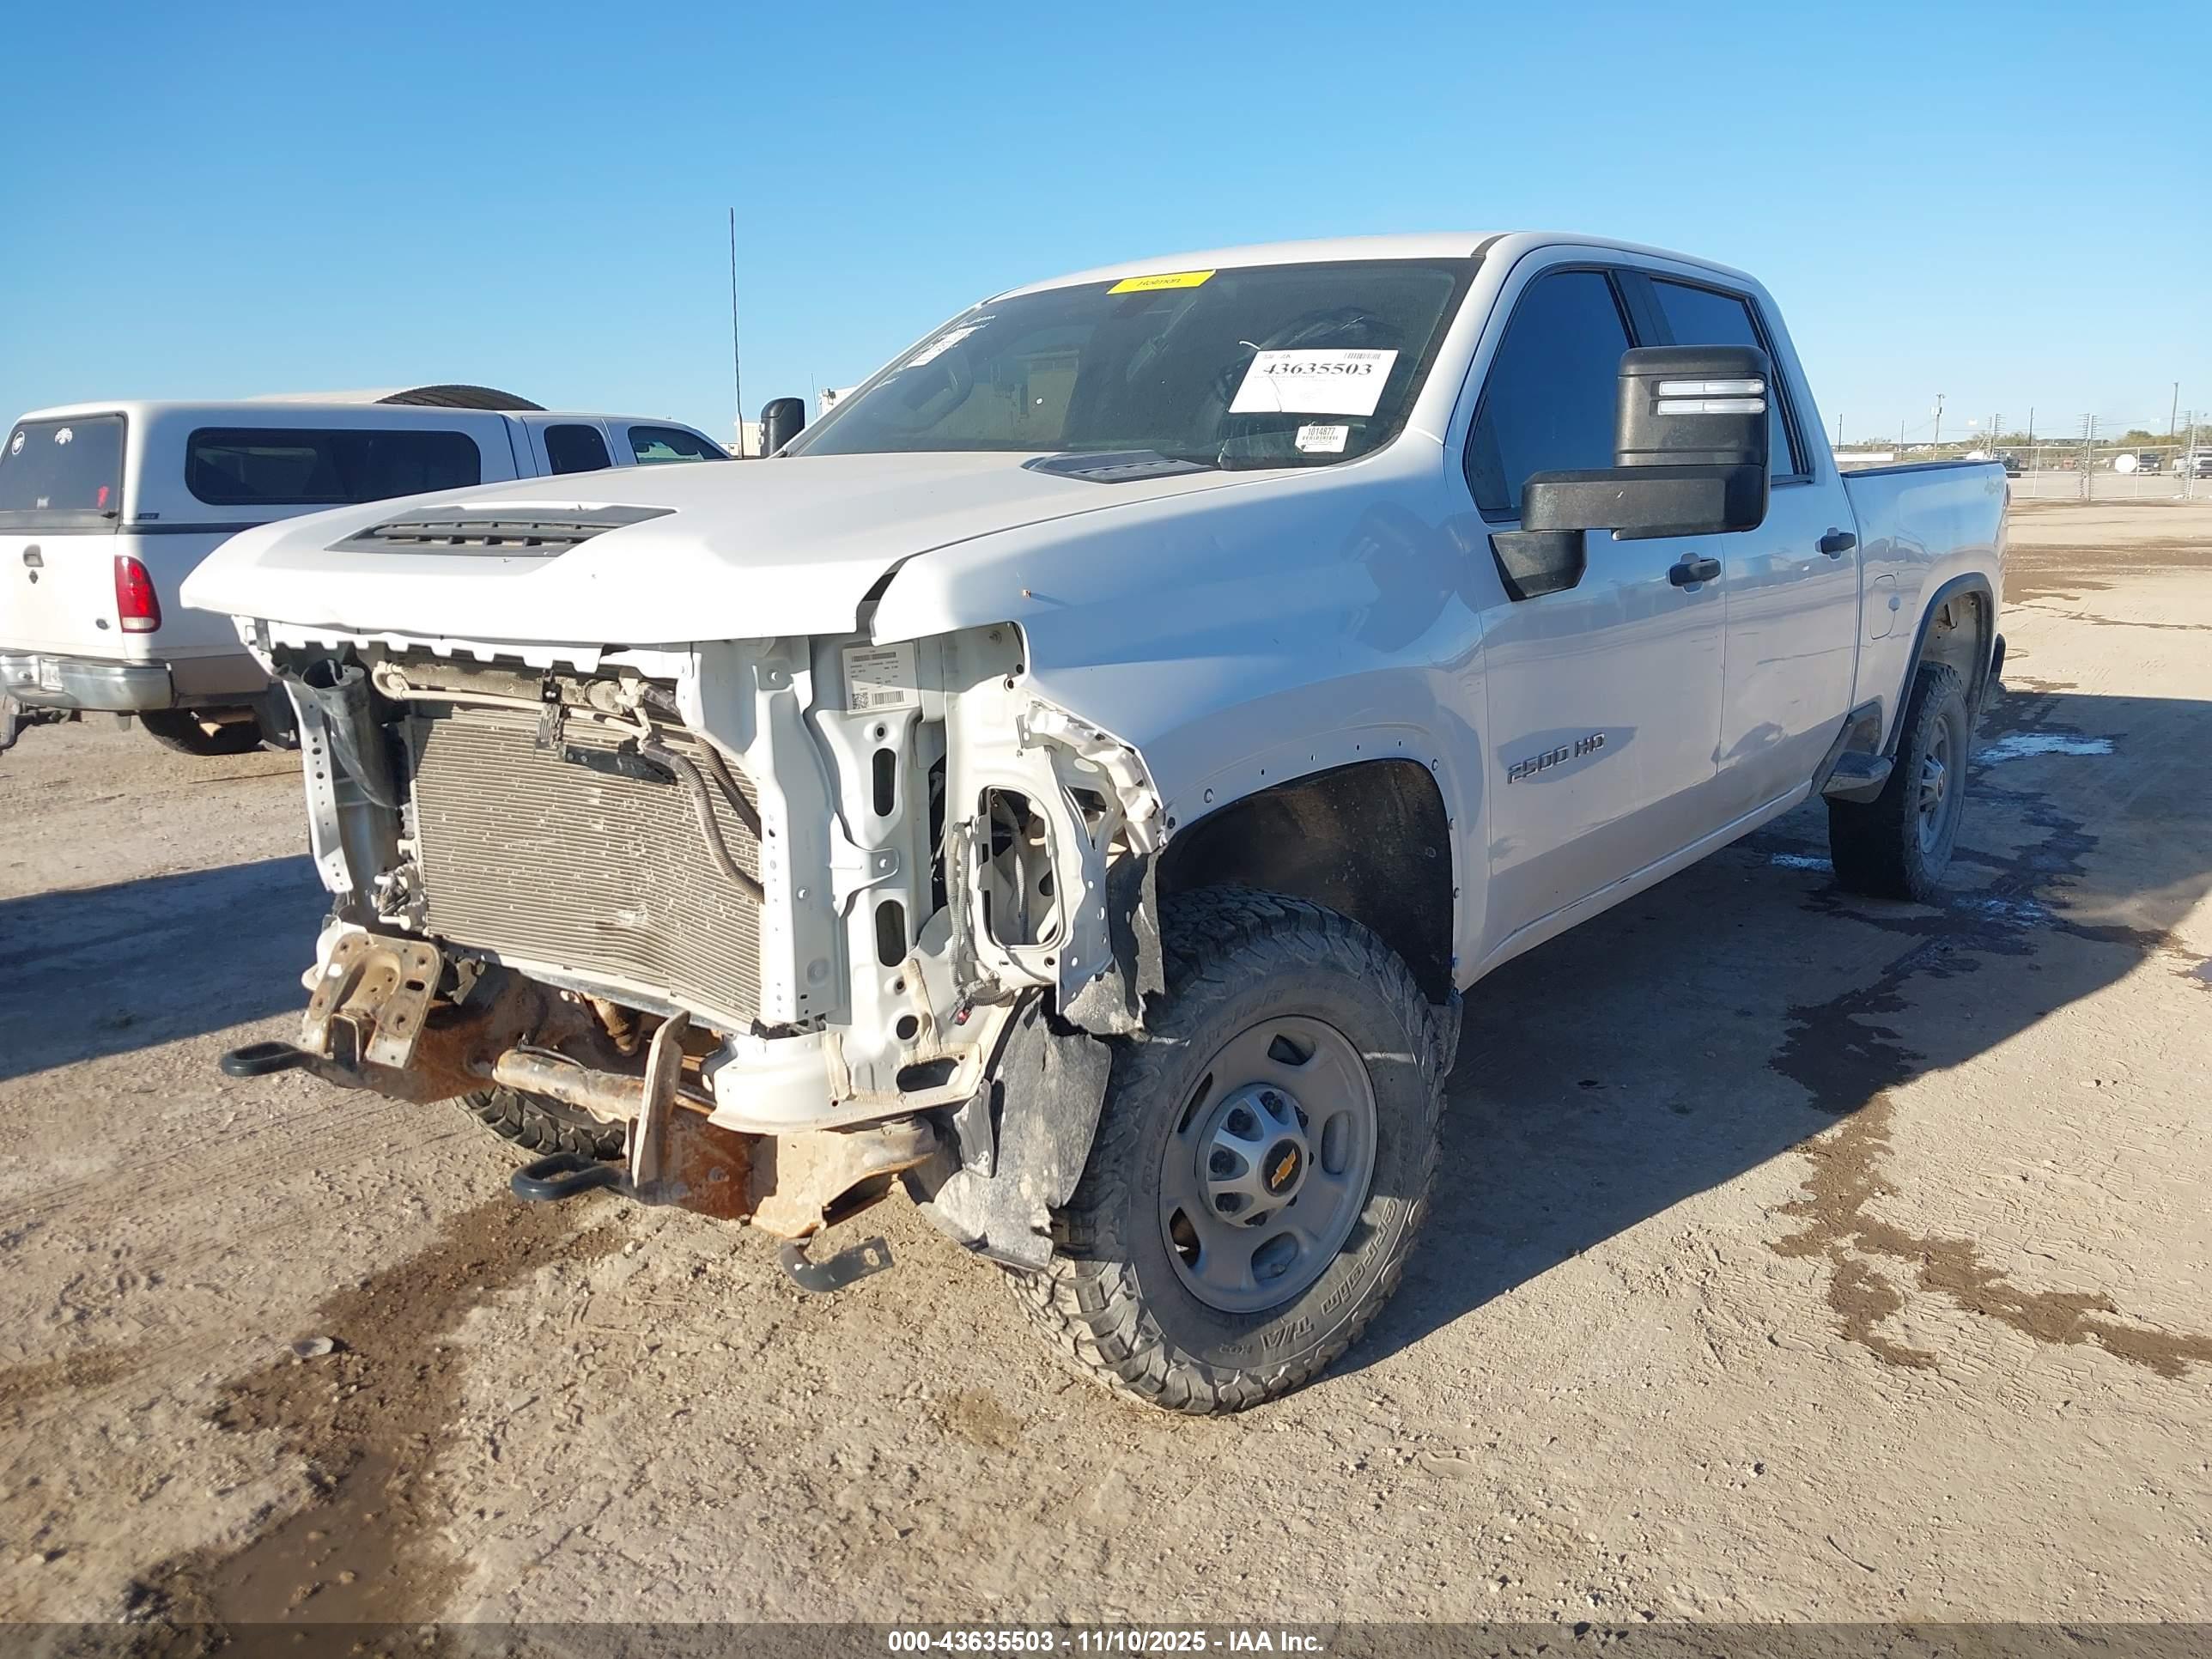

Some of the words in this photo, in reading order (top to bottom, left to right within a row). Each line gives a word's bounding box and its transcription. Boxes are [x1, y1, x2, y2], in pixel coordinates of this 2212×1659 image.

[1263, 362, 1374, 376] 43635503
[1507, 745, 1570, 784] 2500
[1574, 732, 1605, 757] HD
